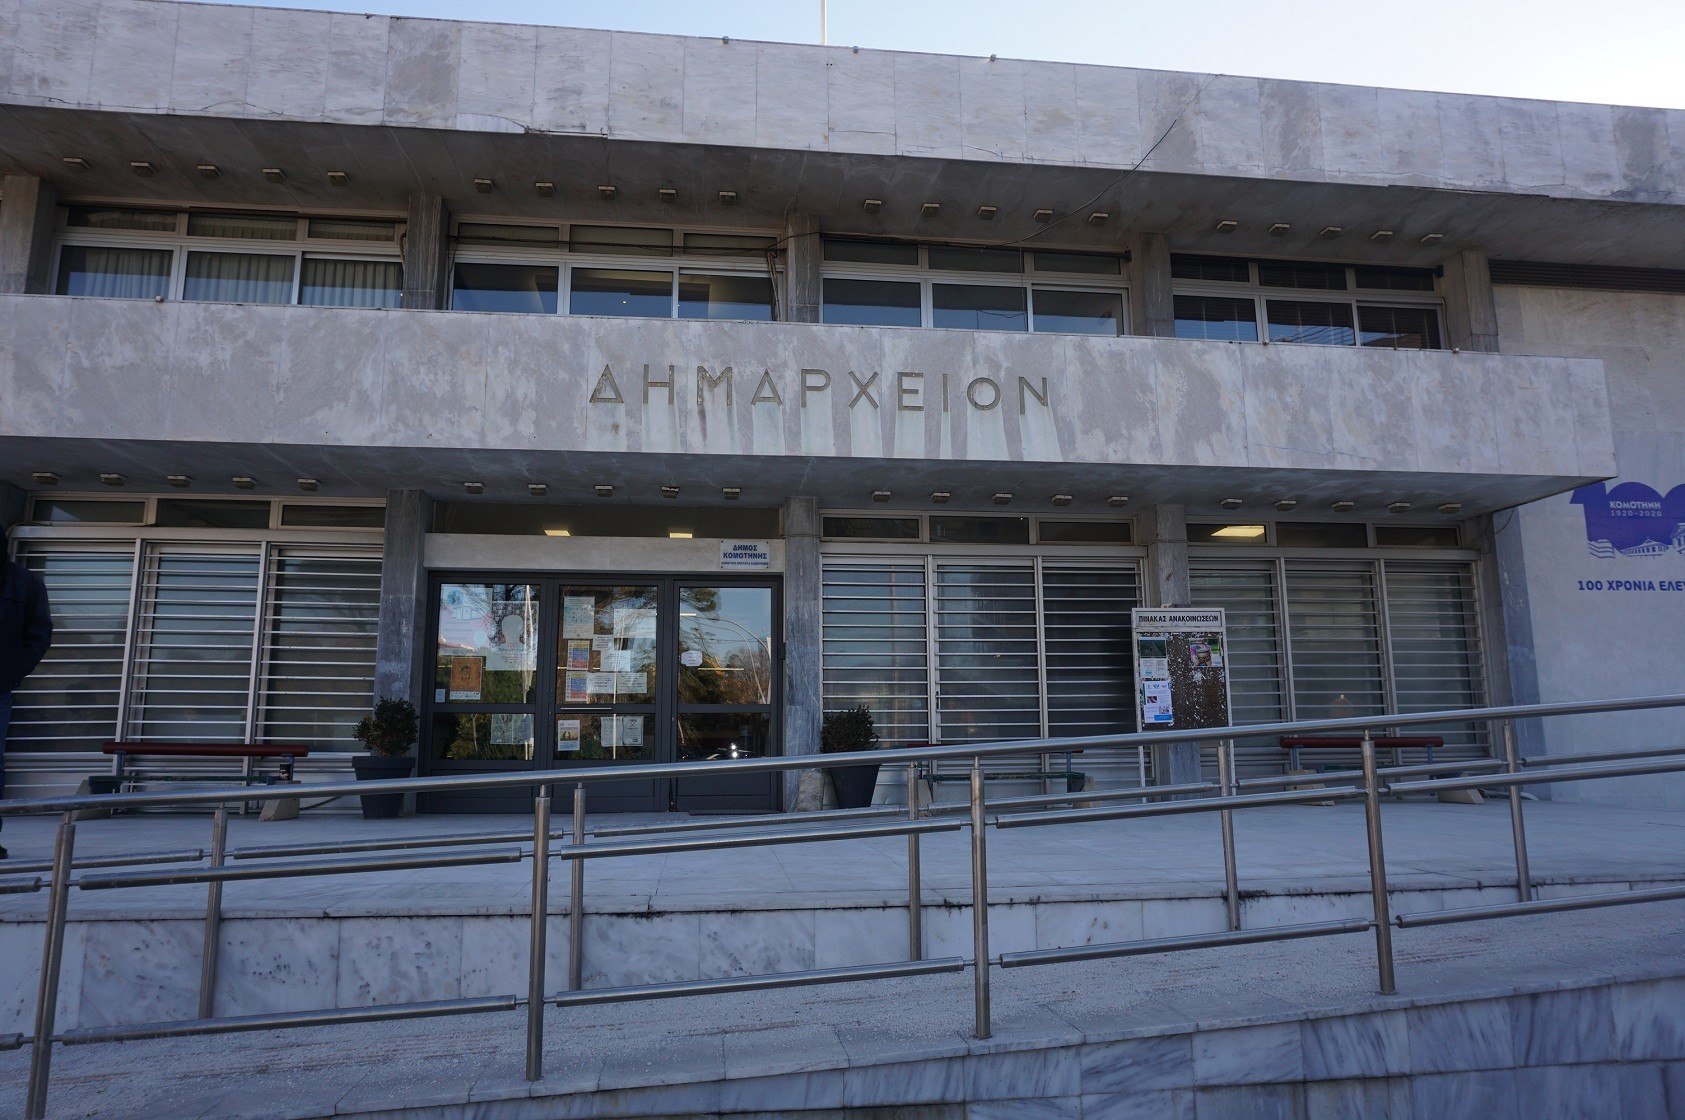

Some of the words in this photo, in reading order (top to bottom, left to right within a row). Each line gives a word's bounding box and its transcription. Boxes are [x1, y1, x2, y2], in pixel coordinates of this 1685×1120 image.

[588, 363, 1050, 416] ΔΗΜΑΡΧΕΙΟΝ
[1609, 501, 1661, 509] ΚΟΜΟΤΗΝΗ
[1578, 580, 1603, 591] 100
[1606, 580, 1656, 591] ΧΡΟΝΙΑ
